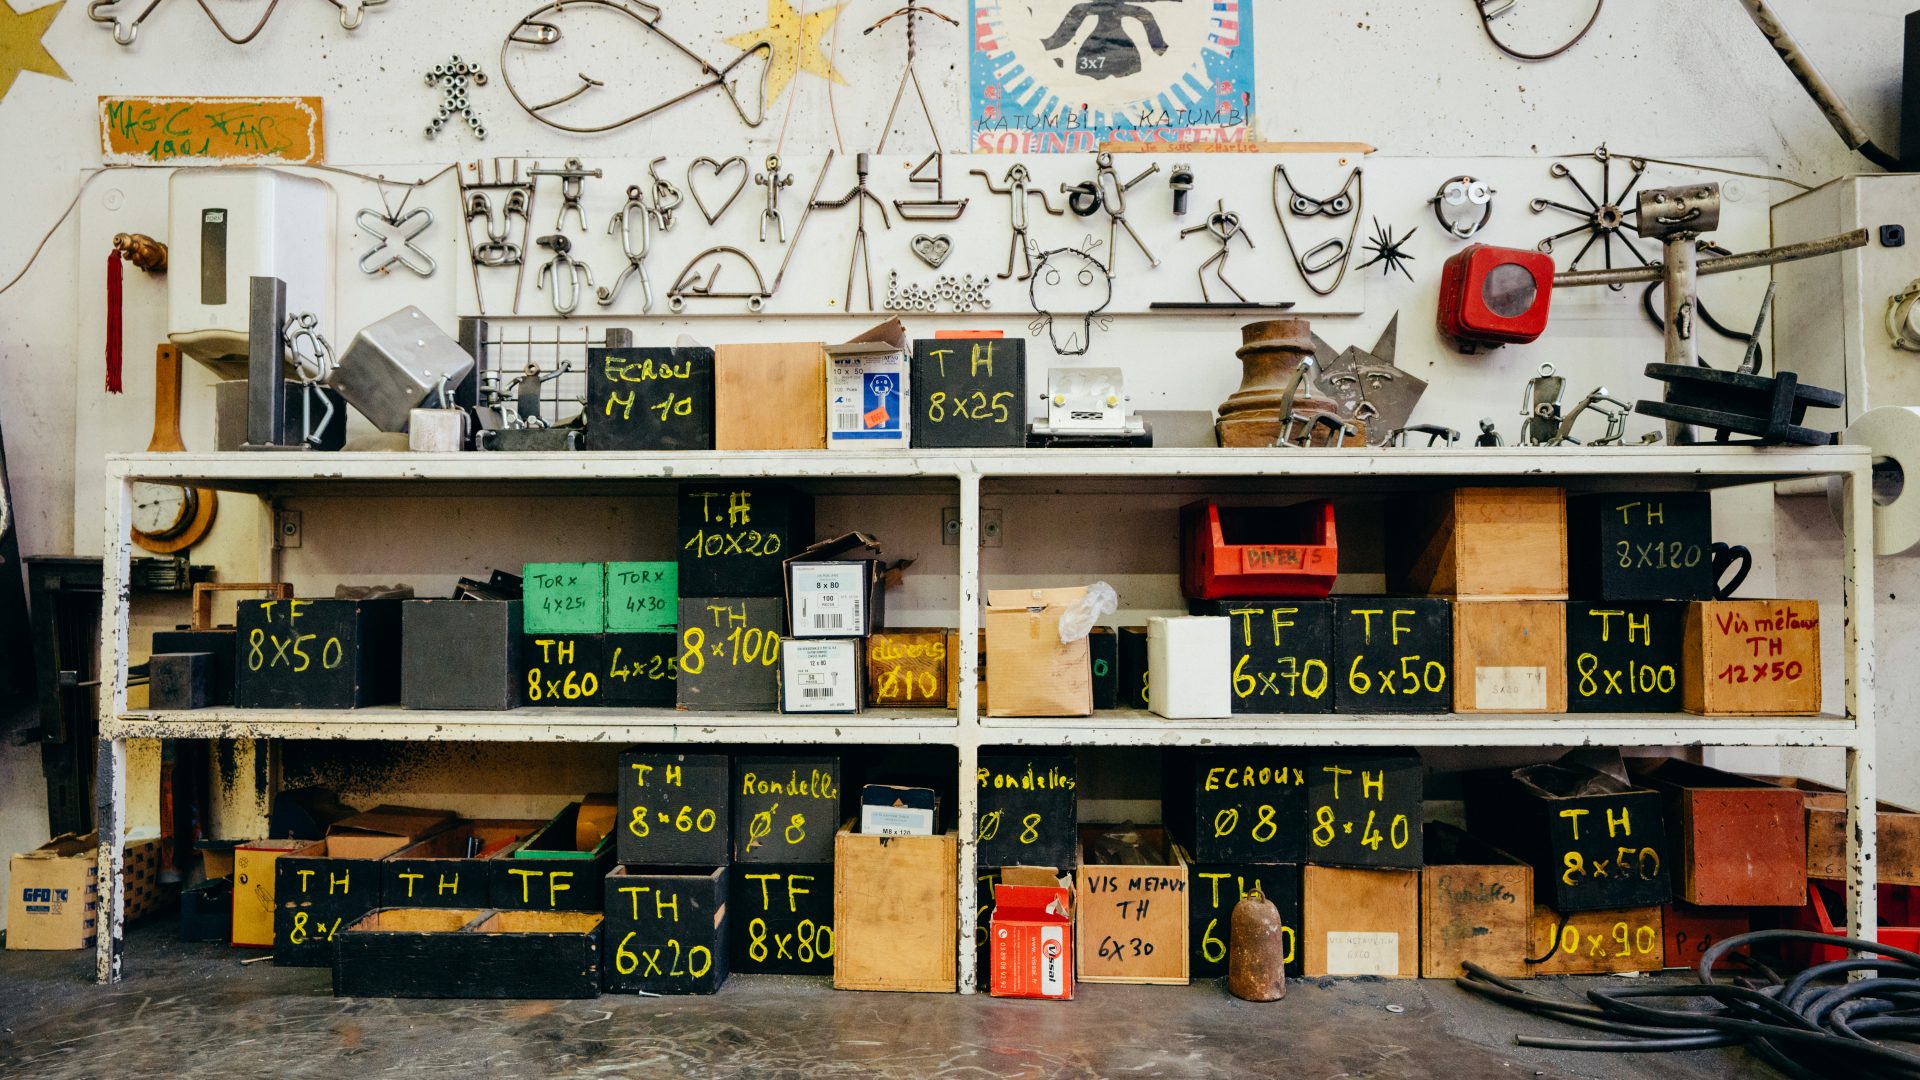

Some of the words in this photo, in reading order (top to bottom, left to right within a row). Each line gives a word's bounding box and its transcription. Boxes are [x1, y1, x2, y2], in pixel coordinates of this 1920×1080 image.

[1079, 58, 1105, 70] 3x7
[977, 131, 1095, 153] SOUND
[605, 391, 635, 419] M
[651, 392, 692, 420] 10
[707, 602, 747, 628] TH
[1230, 607, 1298, 646] TF
[1588, 609, 1651, 646] TH
[1716, 611, 1748, 635] Vis
[535, 639, 574, 665] TH
[1746, 637, 1782, 657] TH
[508, 869, 574, 907] TF
[745, 873, 815, 912] TF
[1088, 876, 1117, 893] VIS
[618, 887, 679, 922] TH
[1048, 946, 1056, 982] Vissal
